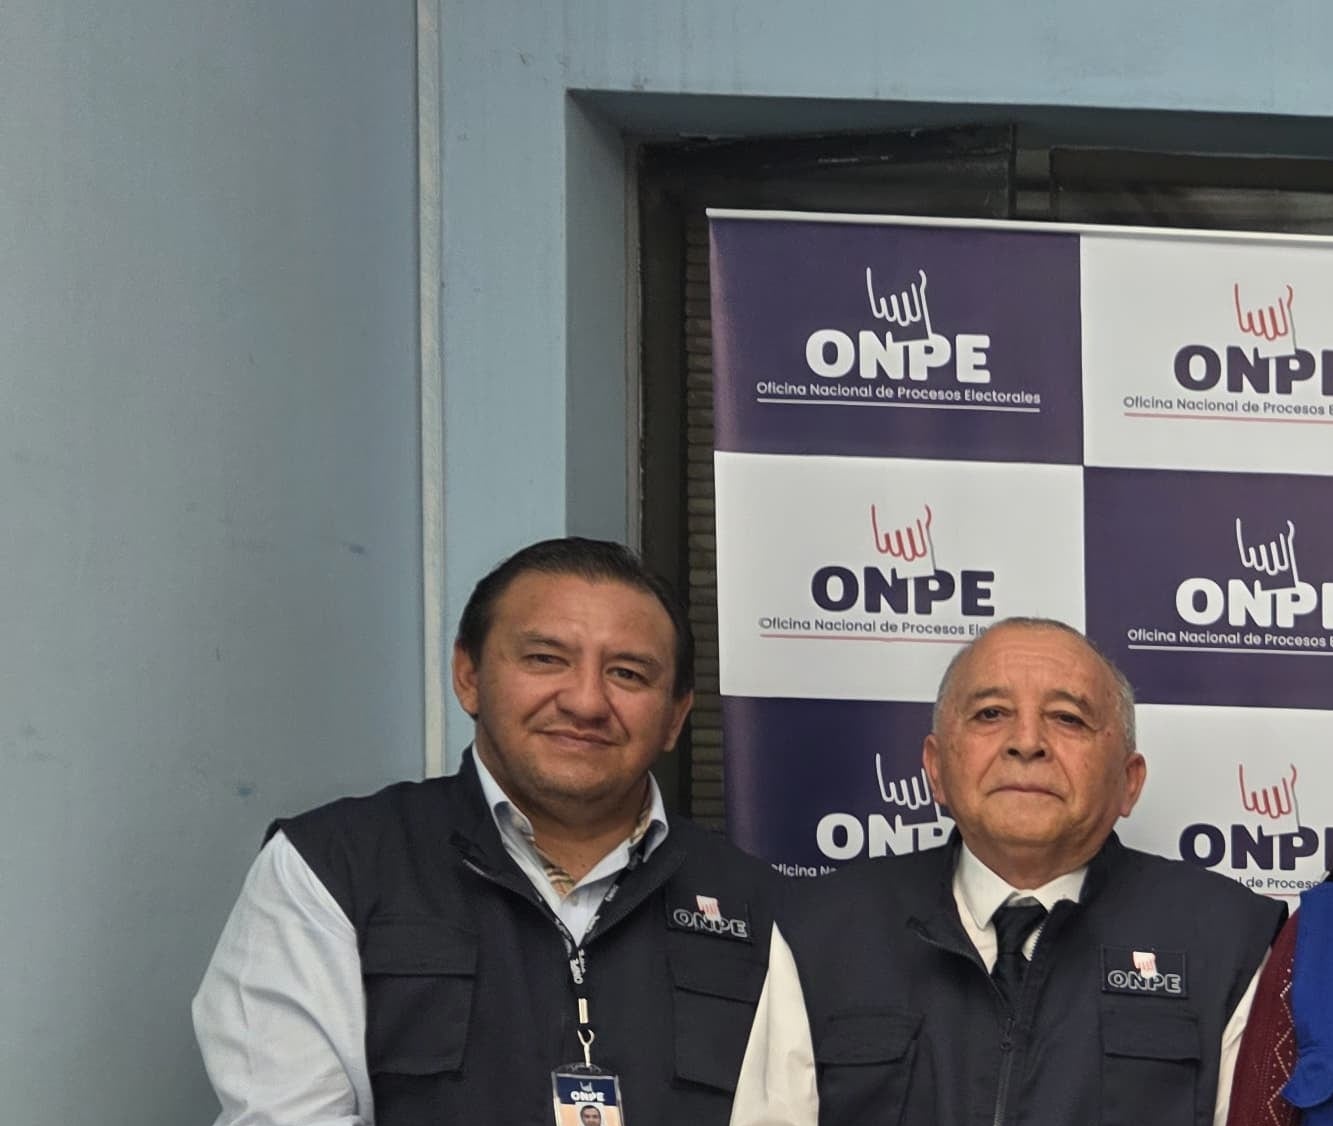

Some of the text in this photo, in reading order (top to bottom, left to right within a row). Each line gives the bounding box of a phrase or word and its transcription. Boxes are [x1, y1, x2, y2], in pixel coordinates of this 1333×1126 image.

[805, 329, 991, 383] ONPE
[756, 381, 1041, 404] Oficina Nacional de Procesos Electorales
[1123, 396, 1173, 409] Oficina
[1177, 397, 1238, 412] Nacional
[1242, 400, 1260, 413] de
[1263, 402, 1325, 416] Procesos
[811, 566, 995, 617] ONPE
[759, 617, 811, 631] Oficina
[815, 619, 876, 633] Nacional
[880, 620, 898, 633] de
[902, 622, 965, 635] Procesos
[1127, 629, 1176, 642] Oficina
[1179, 631, 1241, 645] Nacional
[1244, 632, 1261, 646] de
[1265, 633, 1326, 648] Procesos
[816, 812, 956, 860] ONP
[1246, 877, 1321, 889] de Proces
[673, 908, 748, 938] ONPE
[1108, 970, 1181, 994] ONPE
[570, 1091, 605, 1102] ONPE
